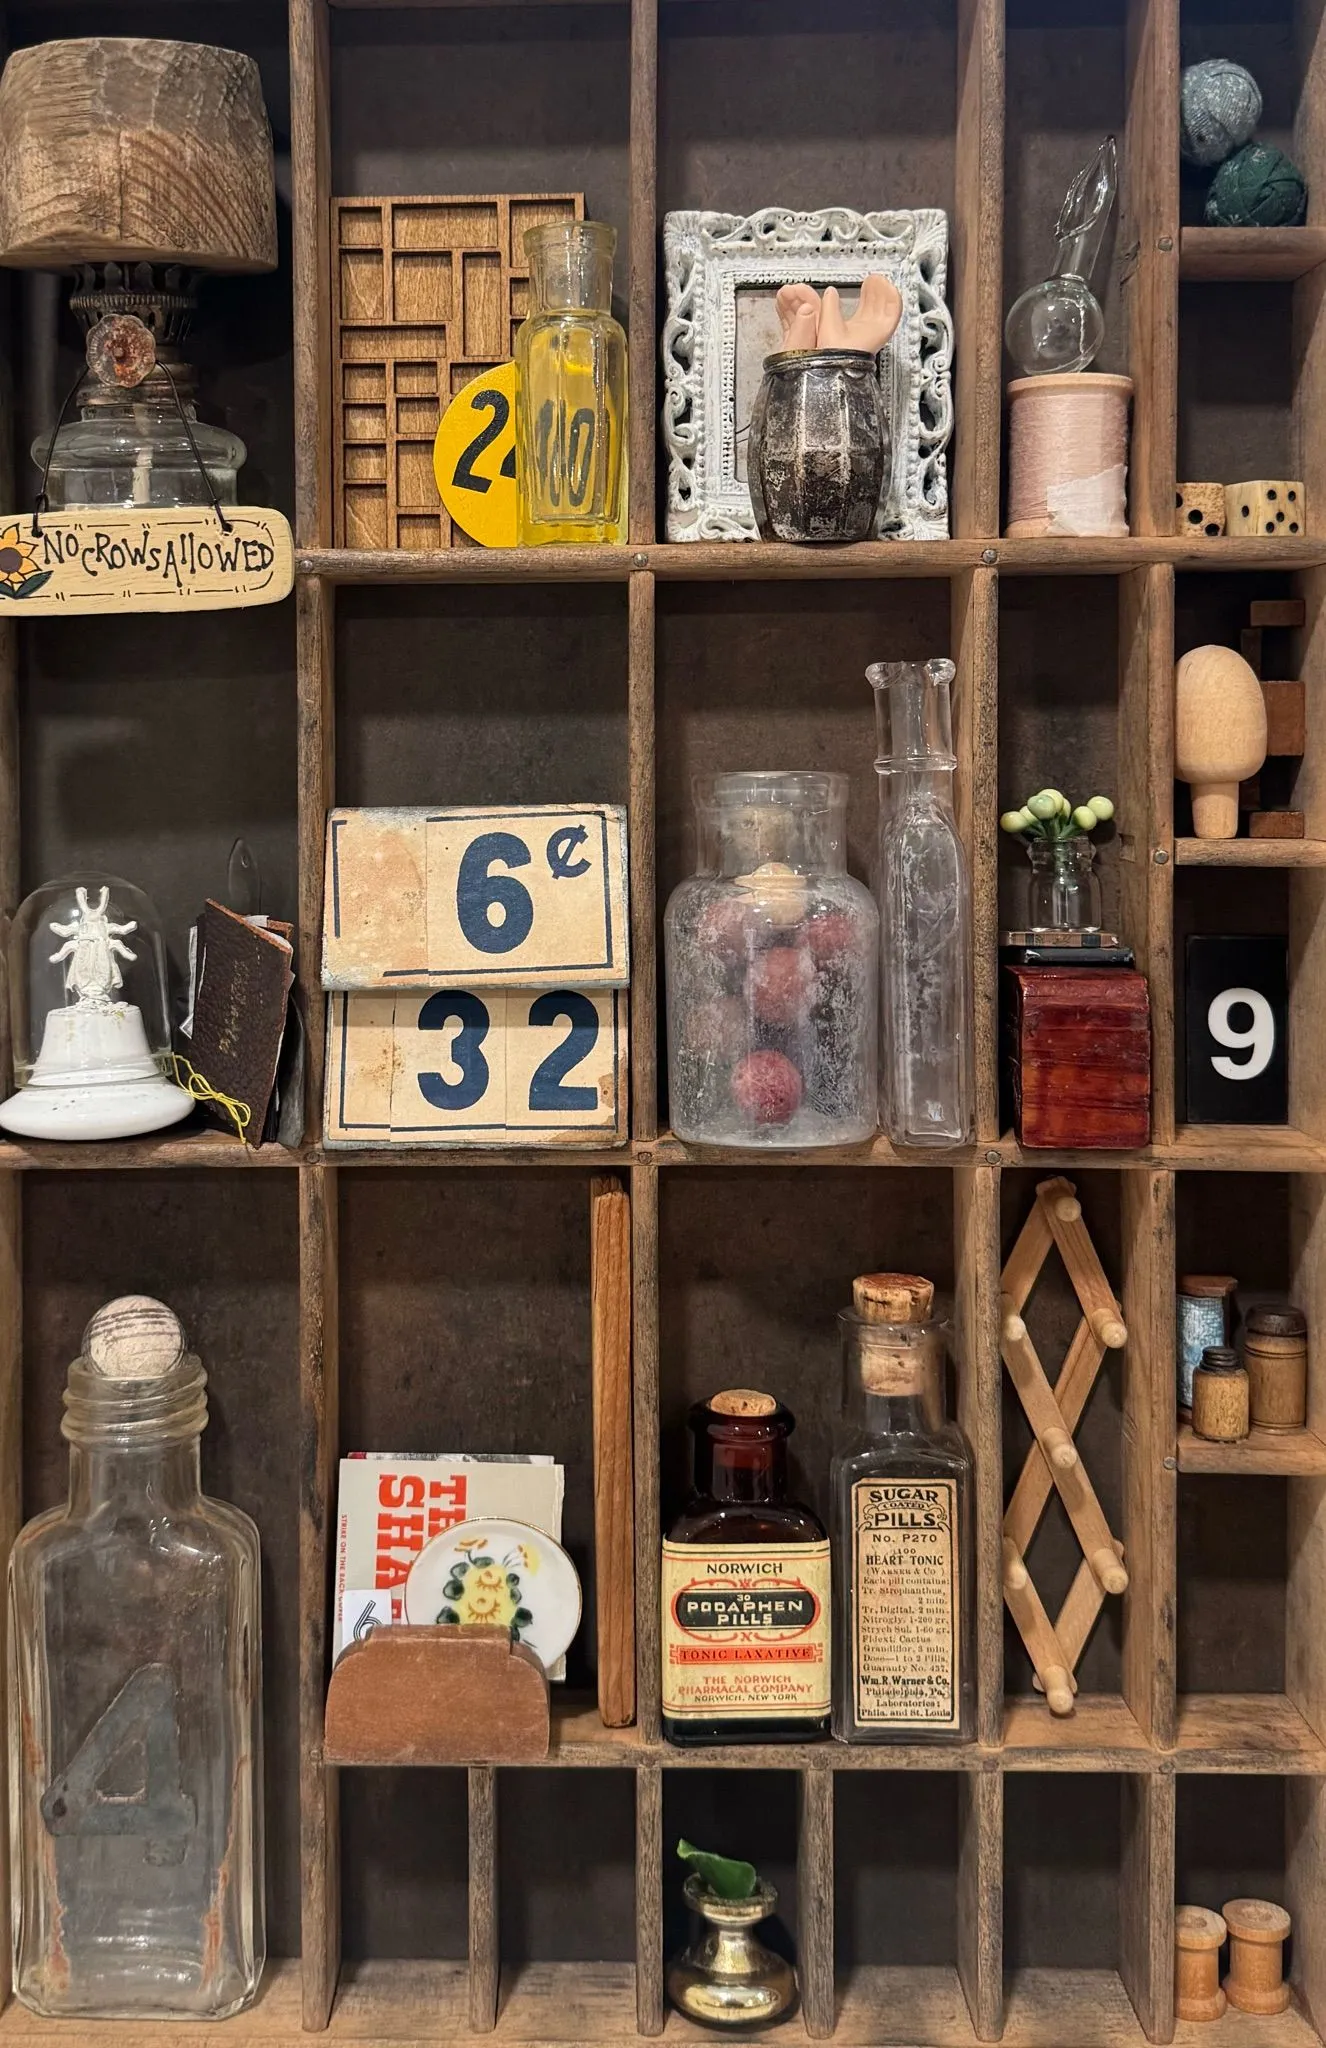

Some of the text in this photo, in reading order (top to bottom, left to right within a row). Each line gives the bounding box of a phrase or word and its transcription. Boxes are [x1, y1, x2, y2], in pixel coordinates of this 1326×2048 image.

[44, 530, 79, 564] NO
[1207, 987, 1276, 1081] 9
[869, 1488, 939, 1504] SUGAR
[882, 1501, 925, 1509] COATED
[874, 1513, 936, 1527] PILLS
[340, 1514, 348, 1539] STRIKE
[902, 1534, 938, 1543] P270
[340, 1541, 347, 1553] ON
[339, 1556, 347, 1571] THE
[865, 1555, 944, 1566] HEART TONIC
[706, 1562, 784, 1575] NORWICH
[338, 1573, 346, 1594] BACK
[863, 1576, 887, 1585] Each
[888, 1576, 904, 1586] pill
[736, 1594, 751, 1602] 30
[687, 1600, 803, 1613] PODAPHEN
[919, 1606, 924, 1614] 2
[717, 1613, 773, 1626] PILLS
[909, 1615, 933, 1623] 1-200
[899, 1635, 931, 1643] Cactus
[680, 1647, 812, 1661] TONIC LAXATIVE
[863, 1664, 908, 1673] Guaranty
[703, 1675, 792, 1685] THE NORWICH
[892, 1675, 926, 1686] Warner
[926, 1675, 934, 1686] &
[935, 1675, 950, 1686] Co.
[678, 1684, 813, 1695] PHARMACAL COMPANY
[694, 1692, 798, 1703] NORWICH, NEW YORK
[876, 1699, 941, 1708] Laboratories:
[889, 1708, 908, 1717] and
[925, 1708, 951, 1717] Louis
